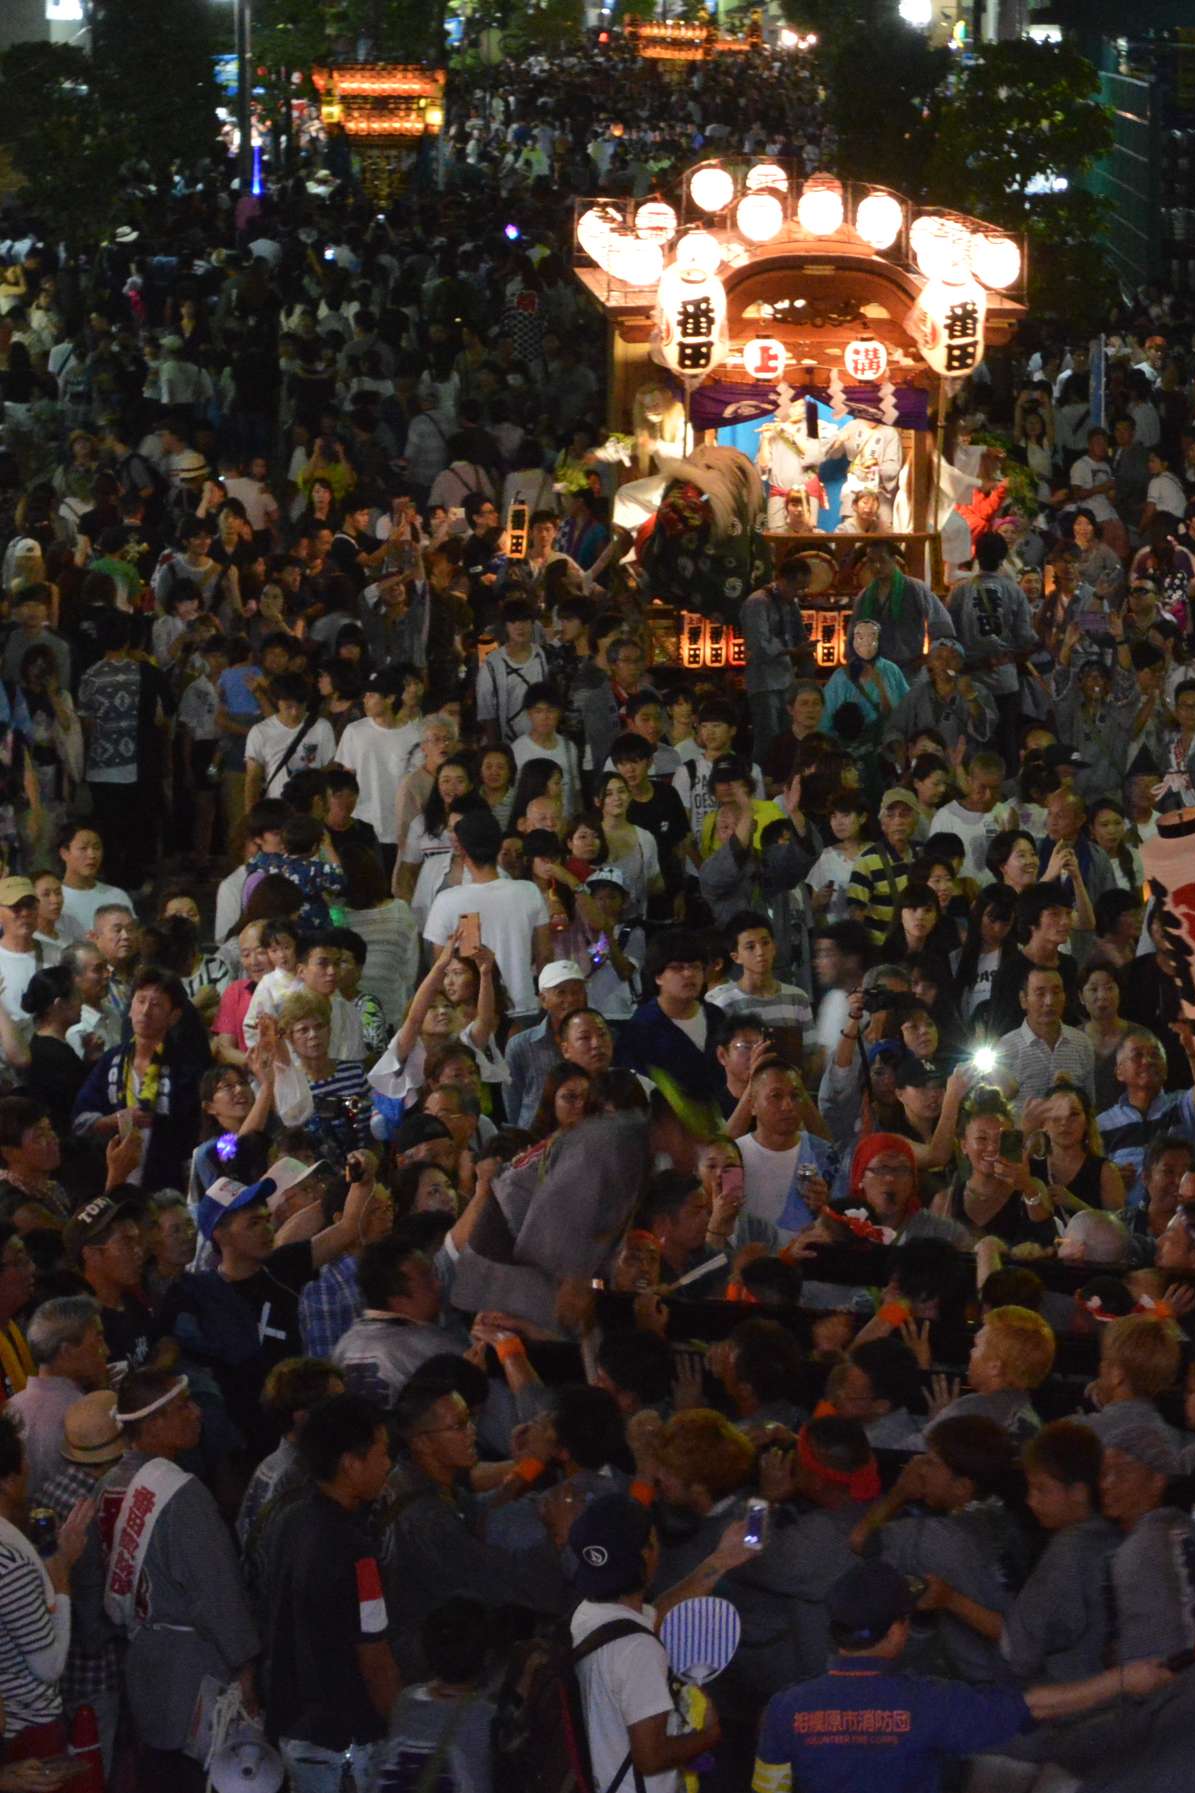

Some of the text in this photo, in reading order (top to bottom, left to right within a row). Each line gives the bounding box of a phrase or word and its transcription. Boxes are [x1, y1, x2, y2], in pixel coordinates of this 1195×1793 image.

[677, 296, 715, 370] 番田
[944, 300, 978, 371] 番田
[754, 346, 779, 373] 上
[852, 347, 881, 375] 溝
[510, 509, 526, 554] 番田
[794, 1710, 911, 1732] 相模原市消防団
